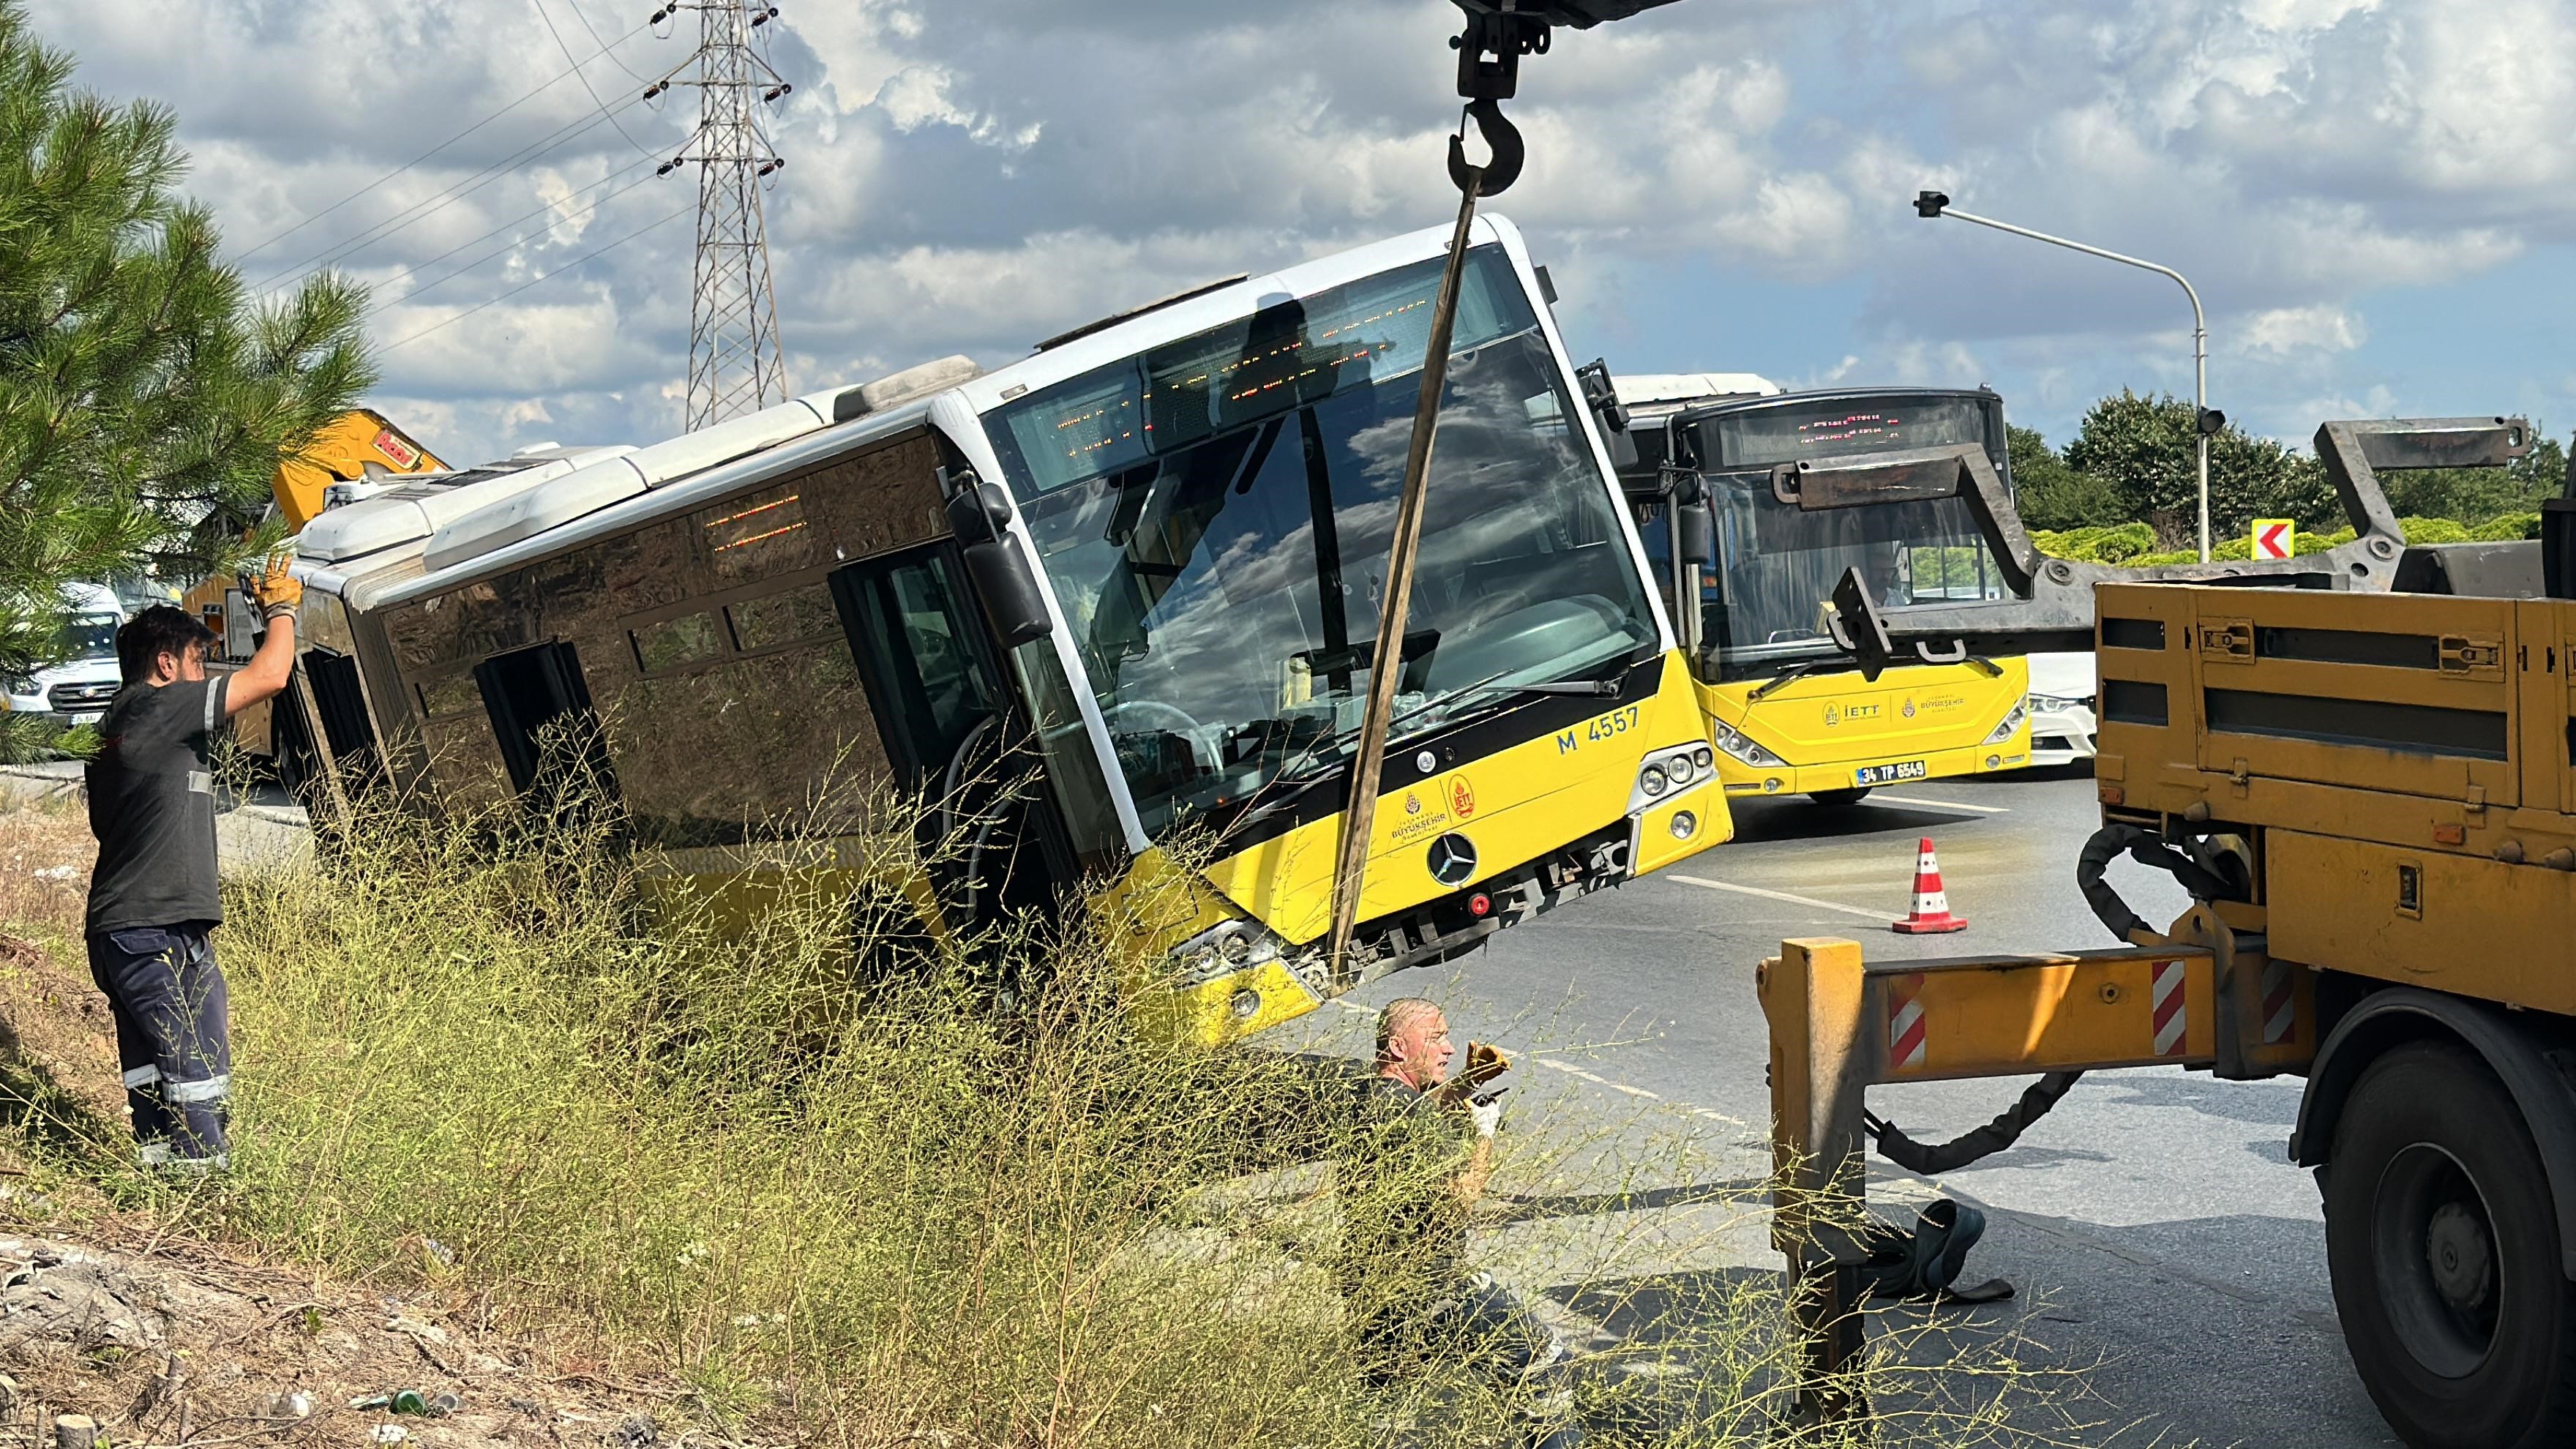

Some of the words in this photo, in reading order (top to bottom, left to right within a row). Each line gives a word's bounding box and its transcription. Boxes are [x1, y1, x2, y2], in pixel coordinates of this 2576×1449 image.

[1557, 730, 1577, 755] M
[1589, 705, 1637, 741] 4557
[1862, 768, 1876, 783] 34
[1880, 765, 1895, 780] TP
[1897, 761, 1924, 778] 6549
